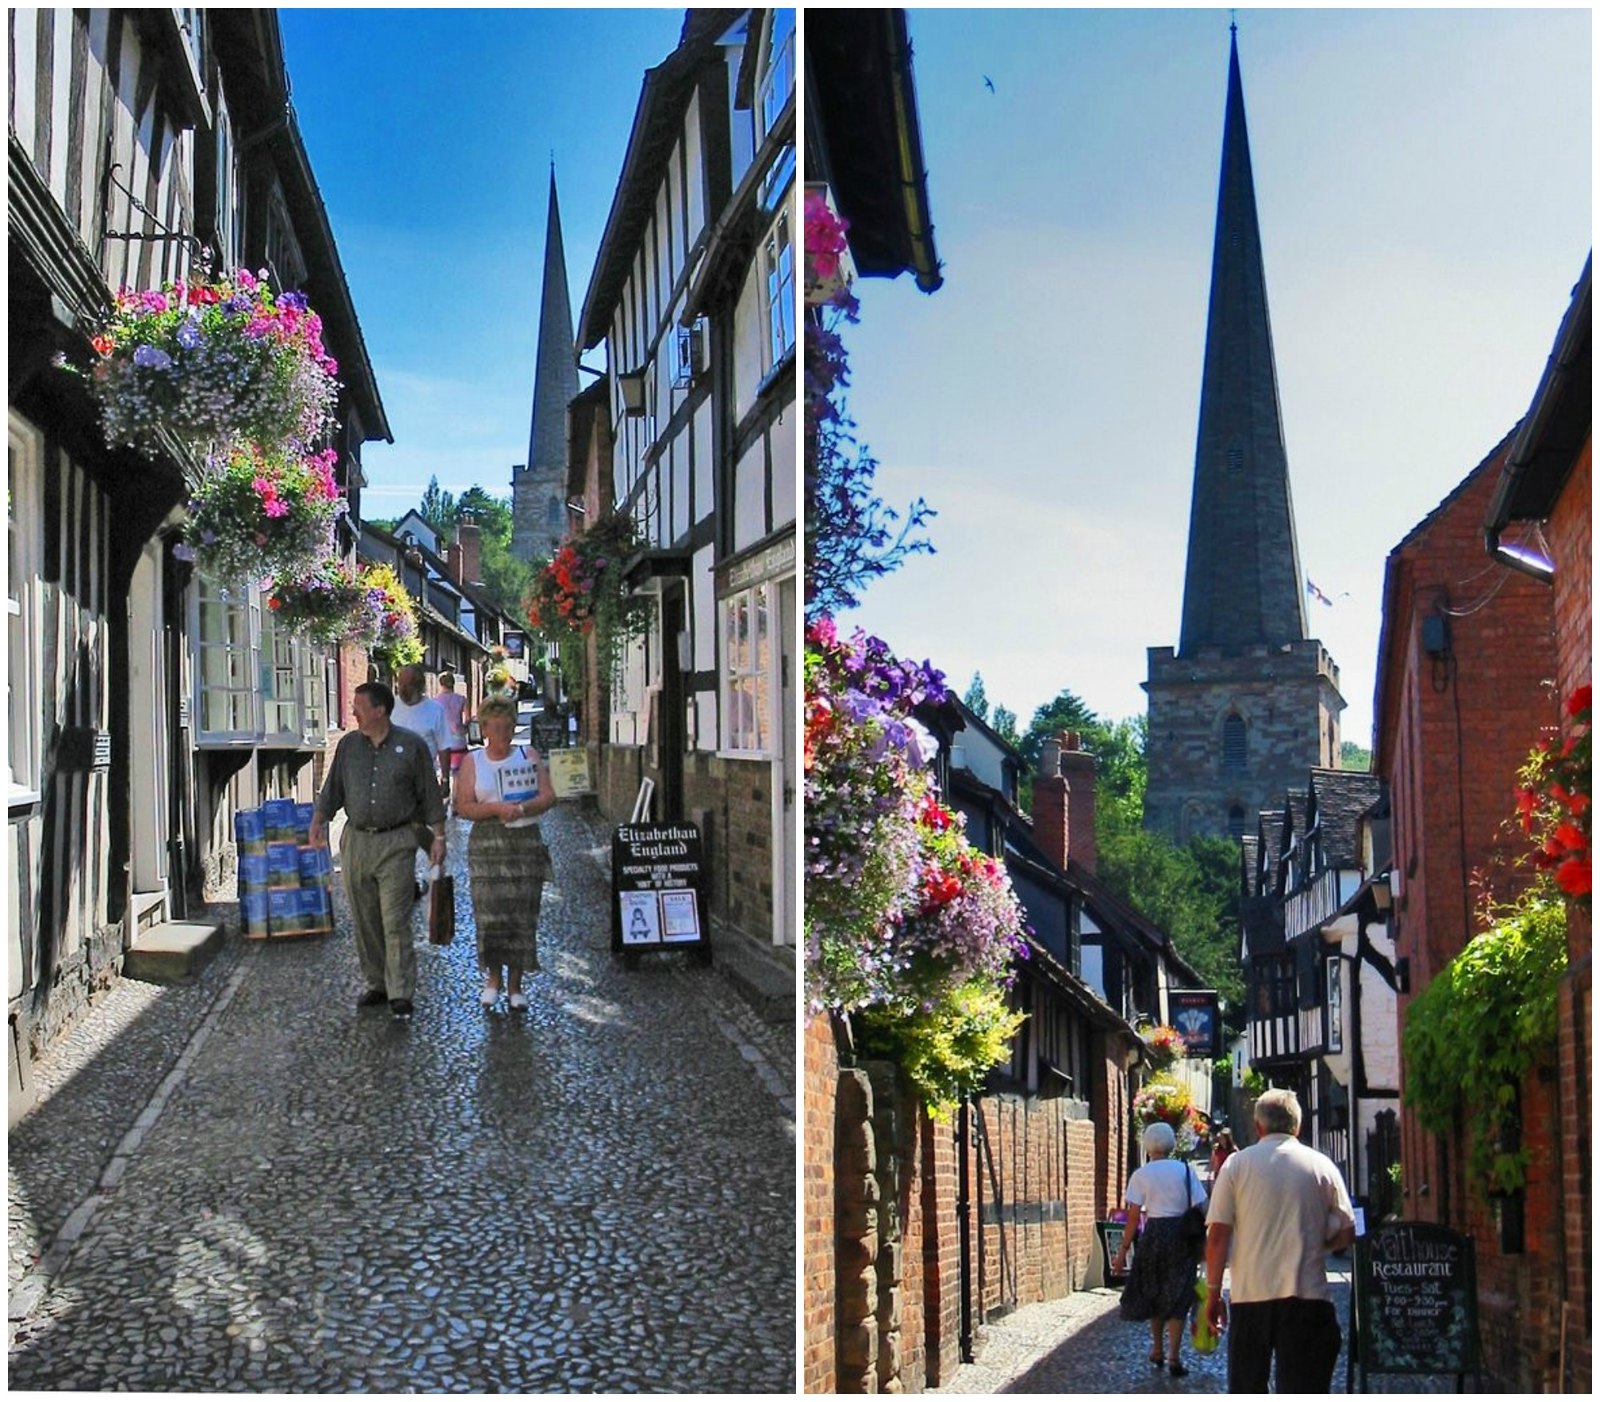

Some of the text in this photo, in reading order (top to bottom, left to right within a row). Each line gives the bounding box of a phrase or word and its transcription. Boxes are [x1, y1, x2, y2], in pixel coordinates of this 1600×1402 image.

[619, 825, 697, 842] Elizabethan
[630, 840, 687, 859] England
[653, 864, 668, 873] FOOD
[1372, 1260, 1453, 1280] Restaurant
